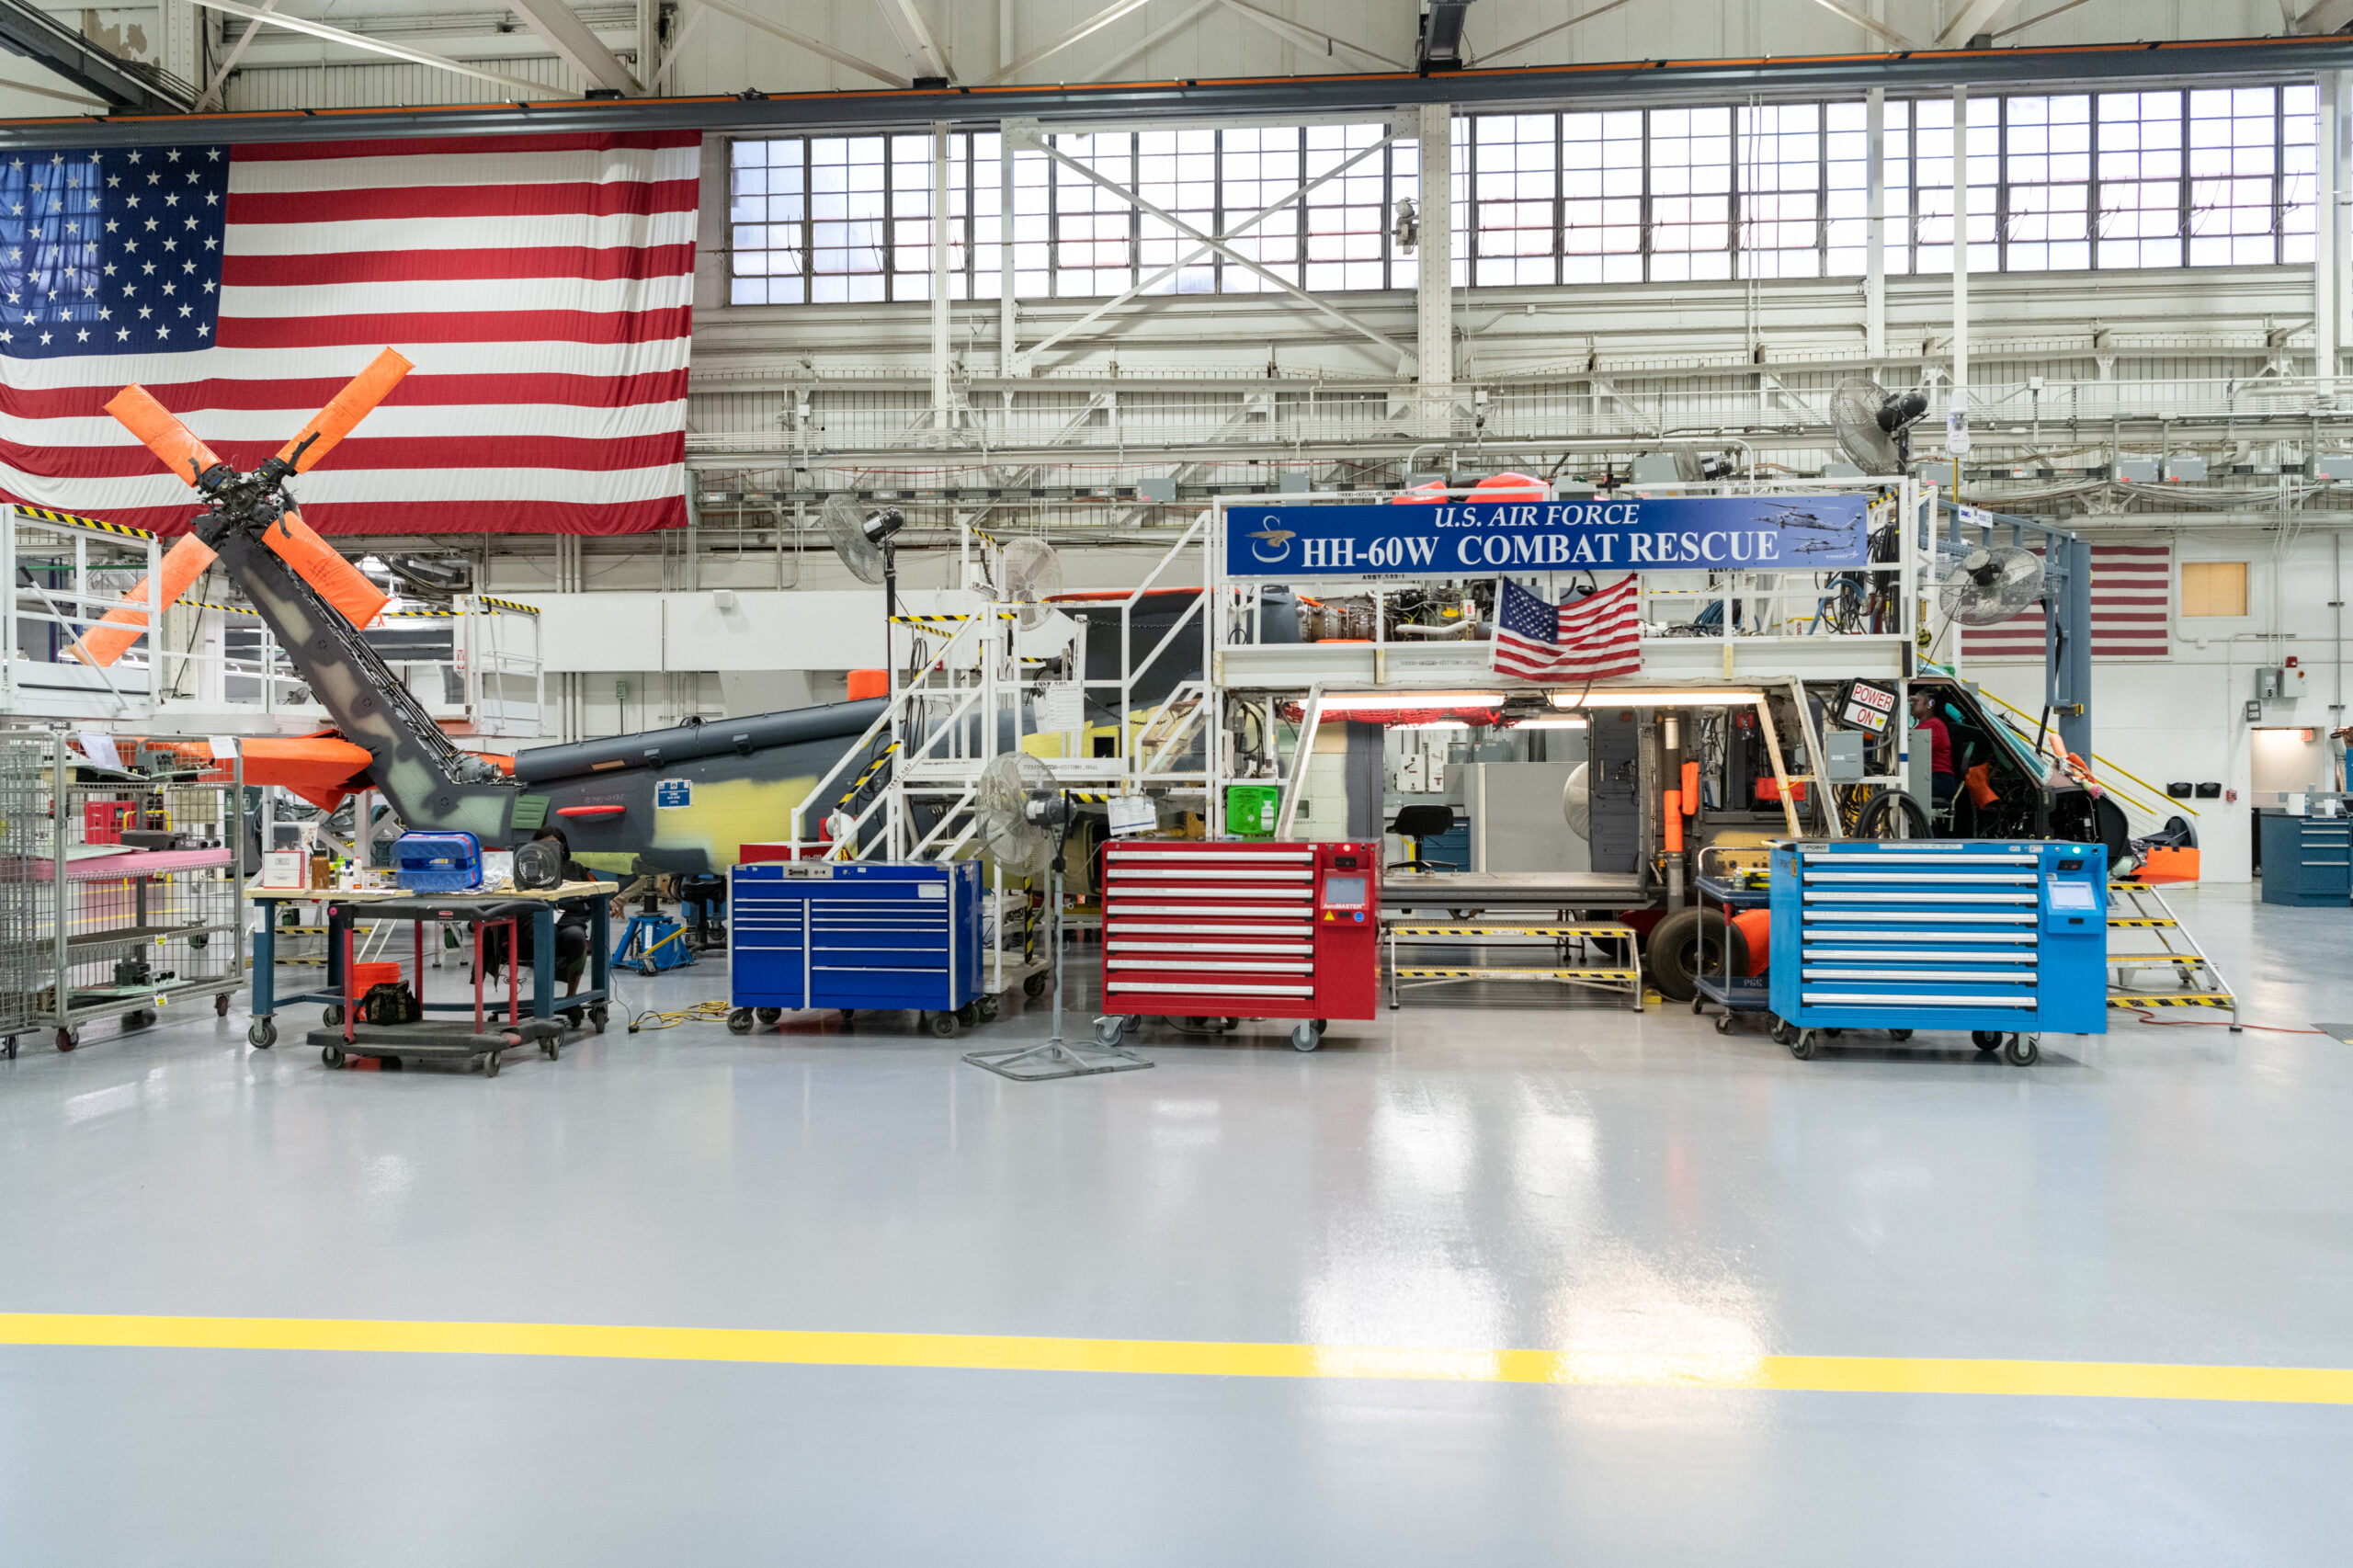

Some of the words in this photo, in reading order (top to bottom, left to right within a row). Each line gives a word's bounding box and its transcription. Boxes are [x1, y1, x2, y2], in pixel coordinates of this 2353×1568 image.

[1435, 506, 1482, 528] U.S.
[1487, 506, 1539, 527] AIR
[1545, 504, 1640, 526] FORCE
[1302, 536, 1439, 568] HH-60W
[1457, 533, 1620, 565] COMBAT
[1628, 530, 1779, 562] RESCUE
[1853, 685, 1893, 710] POWER
[1857, 709, 1875, 726] ON
